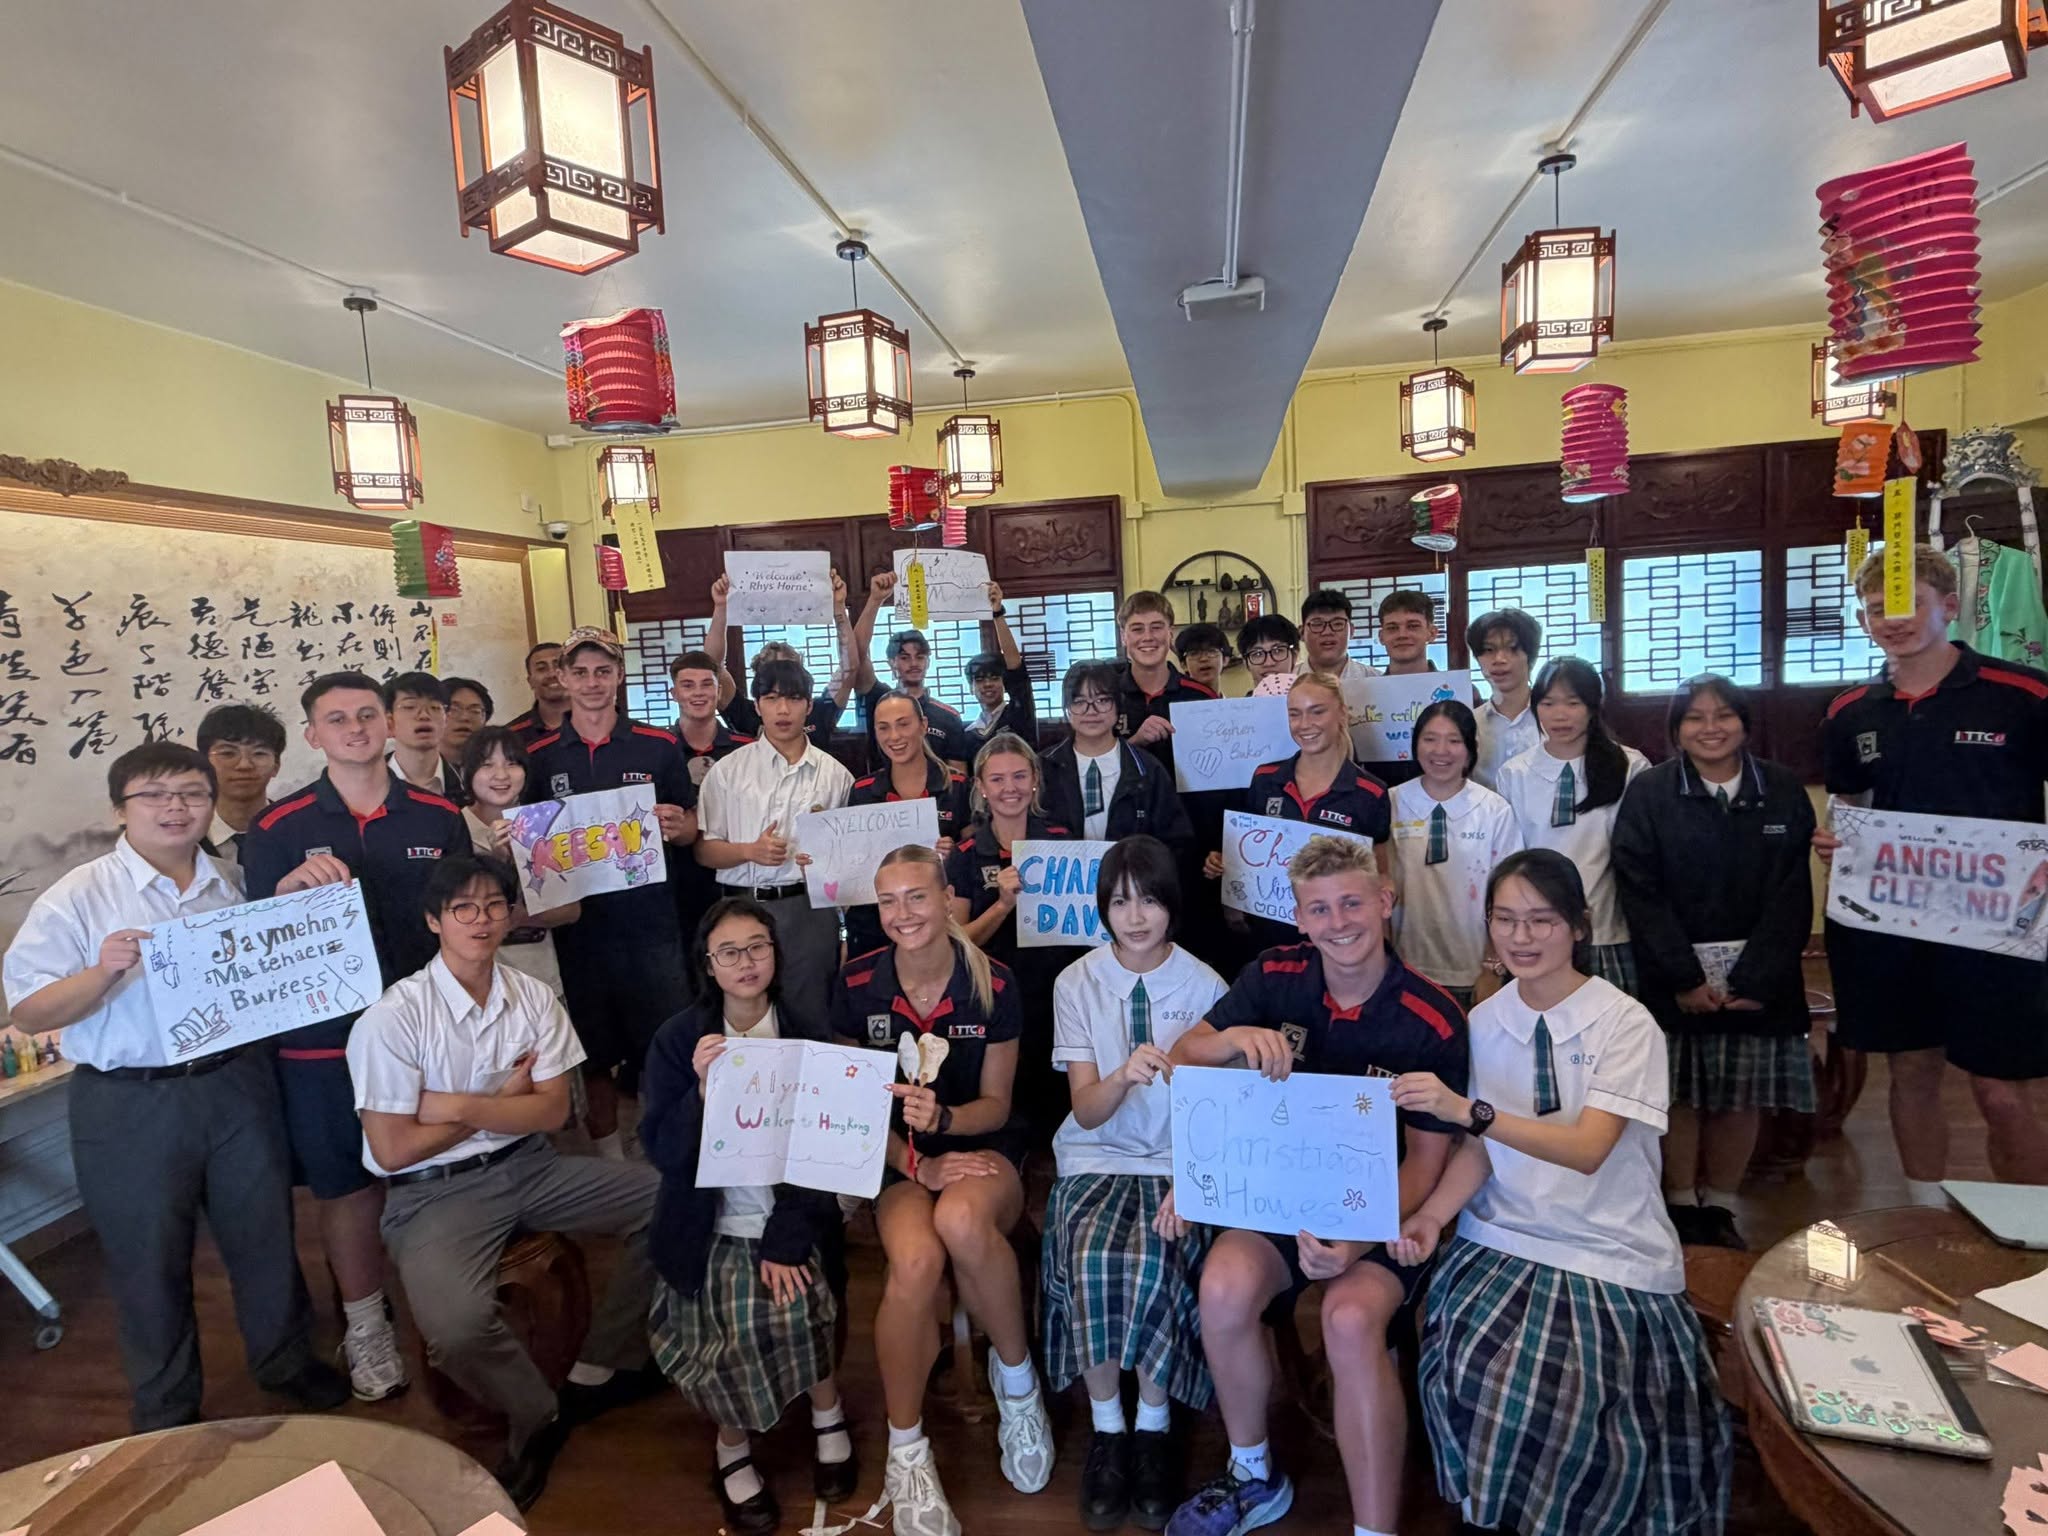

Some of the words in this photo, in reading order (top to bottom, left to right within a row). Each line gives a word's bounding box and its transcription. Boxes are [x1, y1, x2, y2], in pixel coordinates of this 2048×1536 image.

[231, 597, 278, 712] 是陋室
[1873, 841, 2007, 888] ANGUS
[1868, 874, 2014, 923] CLEND
[211, 912, 338, 964] Jaymehn
[229, 970, 328, 1012] Burgess
[1225, 1171, 1344, 1228] Howes
